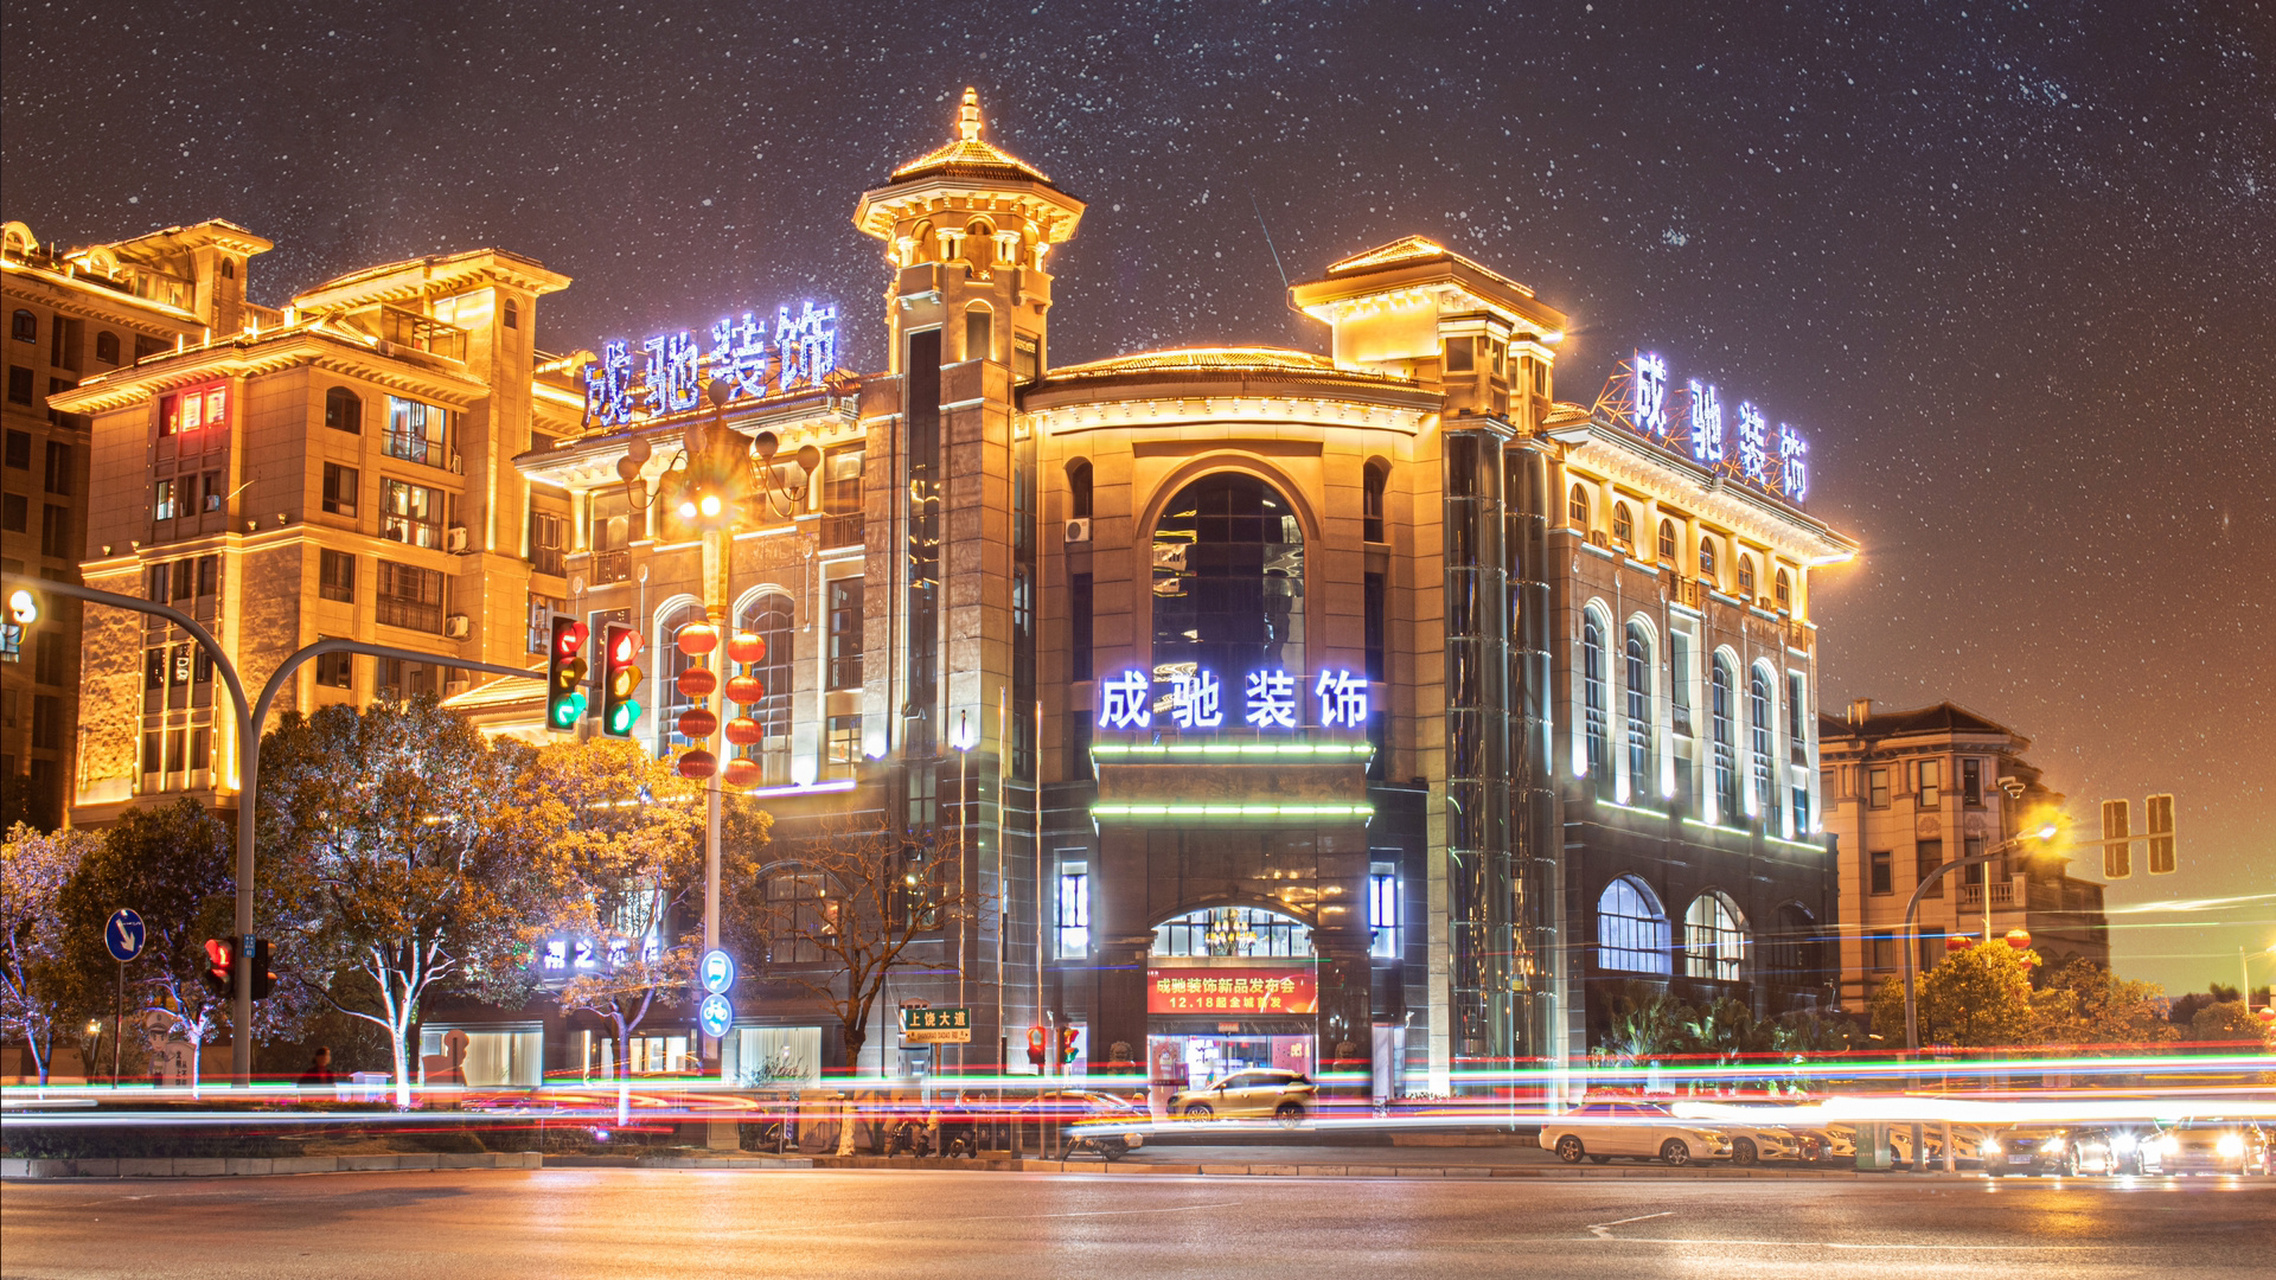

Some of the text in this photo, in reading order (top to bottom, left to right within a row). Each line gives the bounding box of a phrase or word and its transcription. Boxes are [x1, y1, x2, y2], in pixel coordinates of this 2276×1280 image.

[584, 301, 838, 427] 成驰装饰
[1634, 353, 1807, 502] 成驰装饰
[1099, 669, 1368, 728] 成驰装饰
[1156, 978, 1295, 994] 成驰装饰新品发布会
[909, 1011, 966, 1027] 上饶大道
